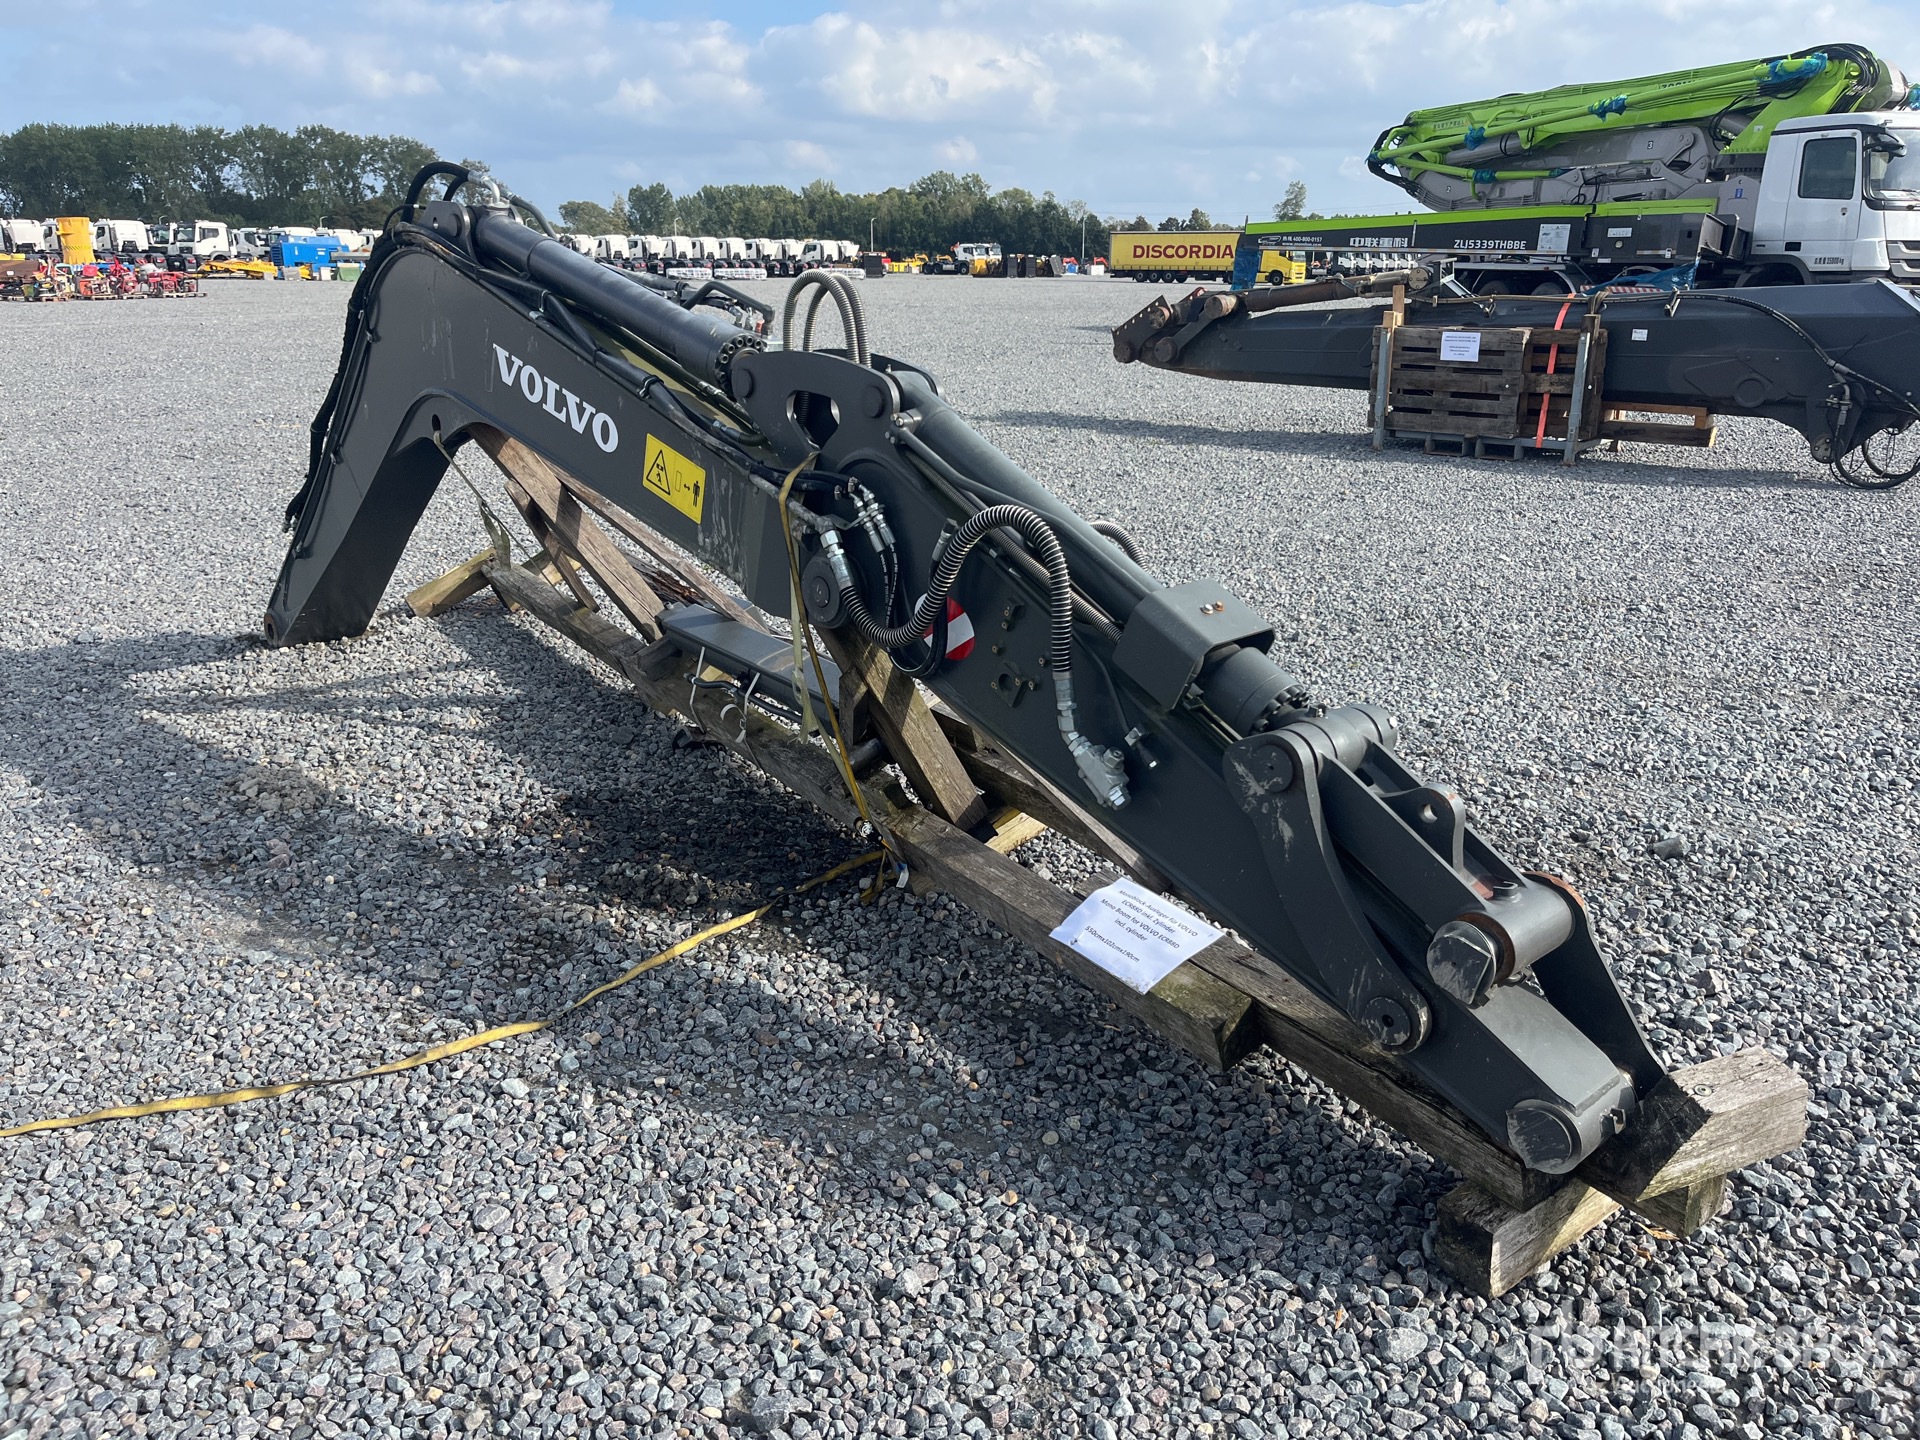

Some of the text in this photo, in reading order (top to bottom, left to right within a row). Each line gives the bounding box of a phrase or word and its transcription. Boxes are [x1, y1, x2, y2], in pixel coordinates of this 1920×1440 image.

[1350, 237, 1408, 248] 中联重科
[1453, 239, 1526, 250] ZLJ5339THBBE
[1133, 245, 1235, 259] DISCORDIA
[493, 343, 619, 453] VOLVO
[1100, 898, 1116, 910] Mono
[1115, 907, 1131, 920] Boom
[1139, 922, 1159, 937] VOLVO
[1158, 934, 1180, 949] ECR88D
[1114, 918, 1147, 941] incl. cylinder
[1152, 918, 1176, 934] Zylinder
[1178, 922, 1198, 937] VOLVO
